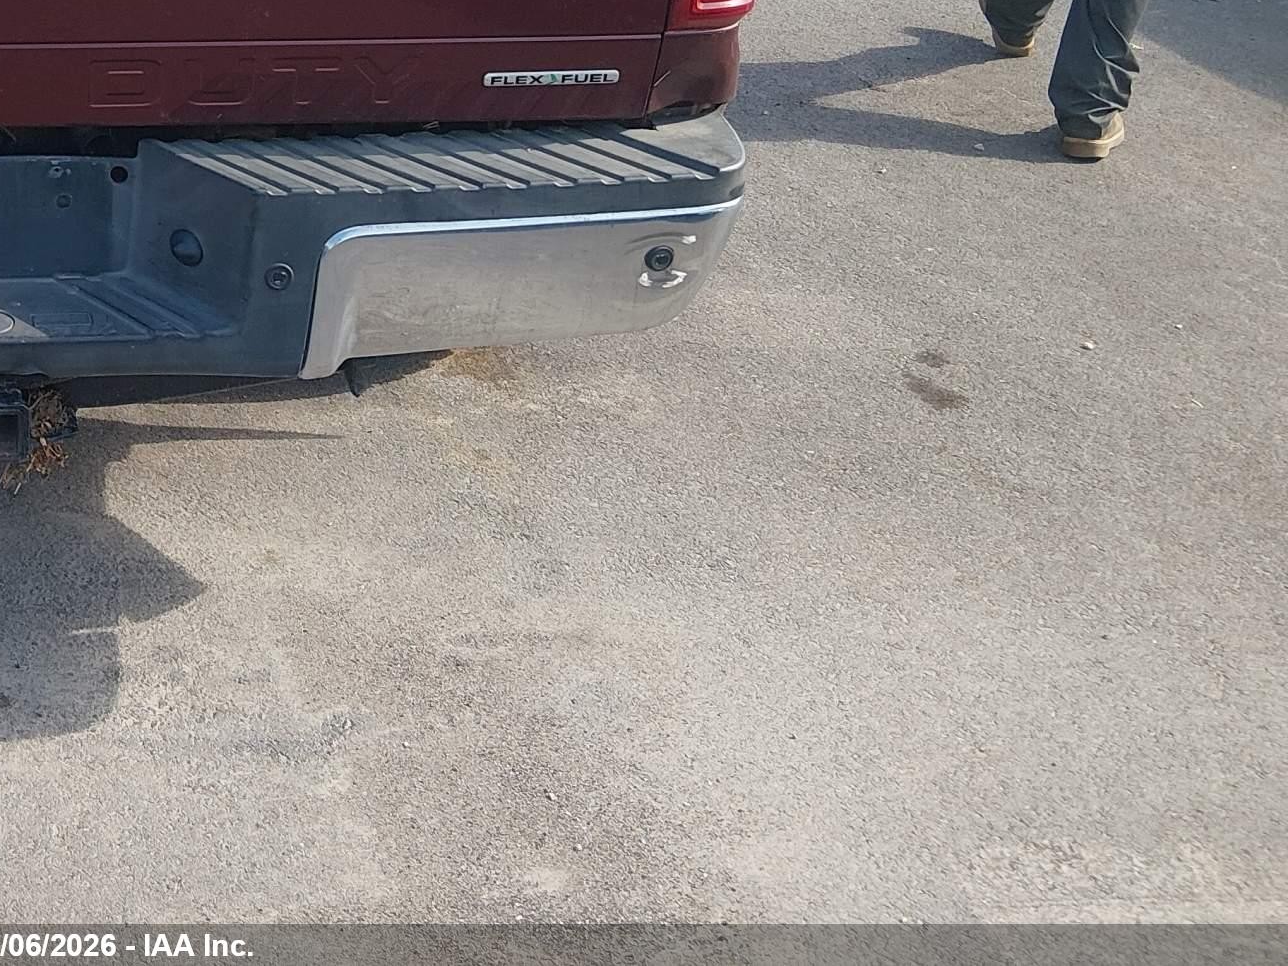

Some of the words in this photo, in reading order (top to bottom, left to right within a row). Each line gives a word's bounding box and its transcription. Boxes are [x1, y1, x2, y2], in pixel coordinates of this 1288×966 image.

[88, 56, 420, 108] DUTY
[490, 75, 544, 85] FLEX
[561, 73, 615, 84] FUEL
